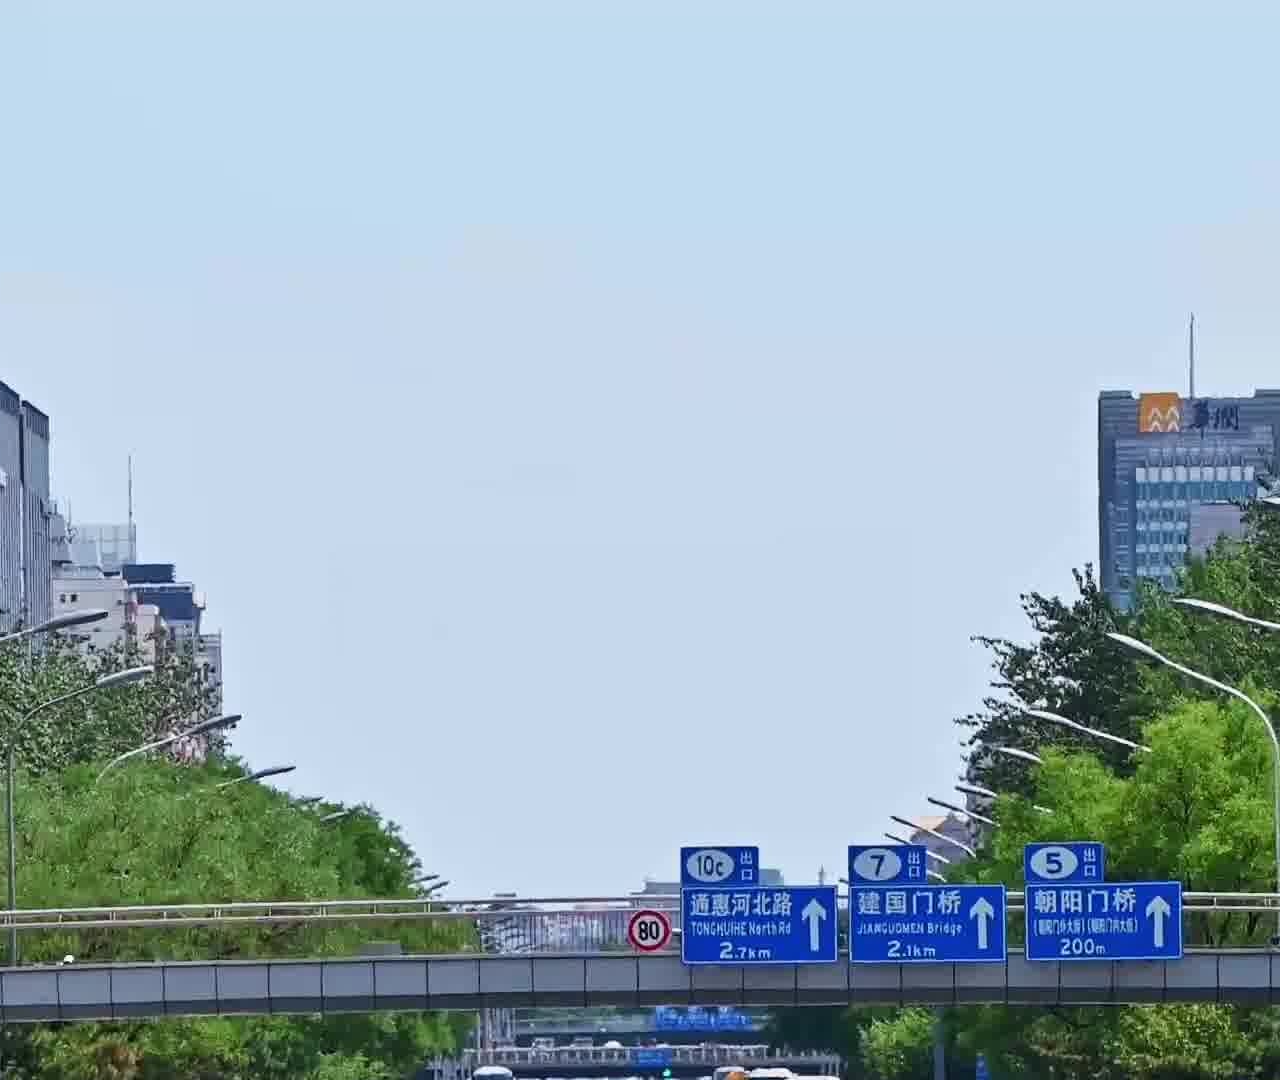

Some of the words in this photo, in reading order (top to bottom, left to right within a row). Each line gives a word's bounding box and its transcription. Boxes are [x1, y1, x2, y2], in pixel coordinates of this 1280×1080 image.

[740, 850, 753, 881] 出口
[870, 854, 885, 877] 7
[908, 851, 921, 879] 出口
[1045, 852, 1063, 874] 5
[1083, 848, 1096, 877] 出口
[690, 893, 793, 917] 通惠河北路
[857, 890, 961, 915] 建国门桥
[1034, 888, 1136, 913] 朝阳门桥
[638, 921, 660, 941] 80
[927, 922, 962, 936] Bridge
